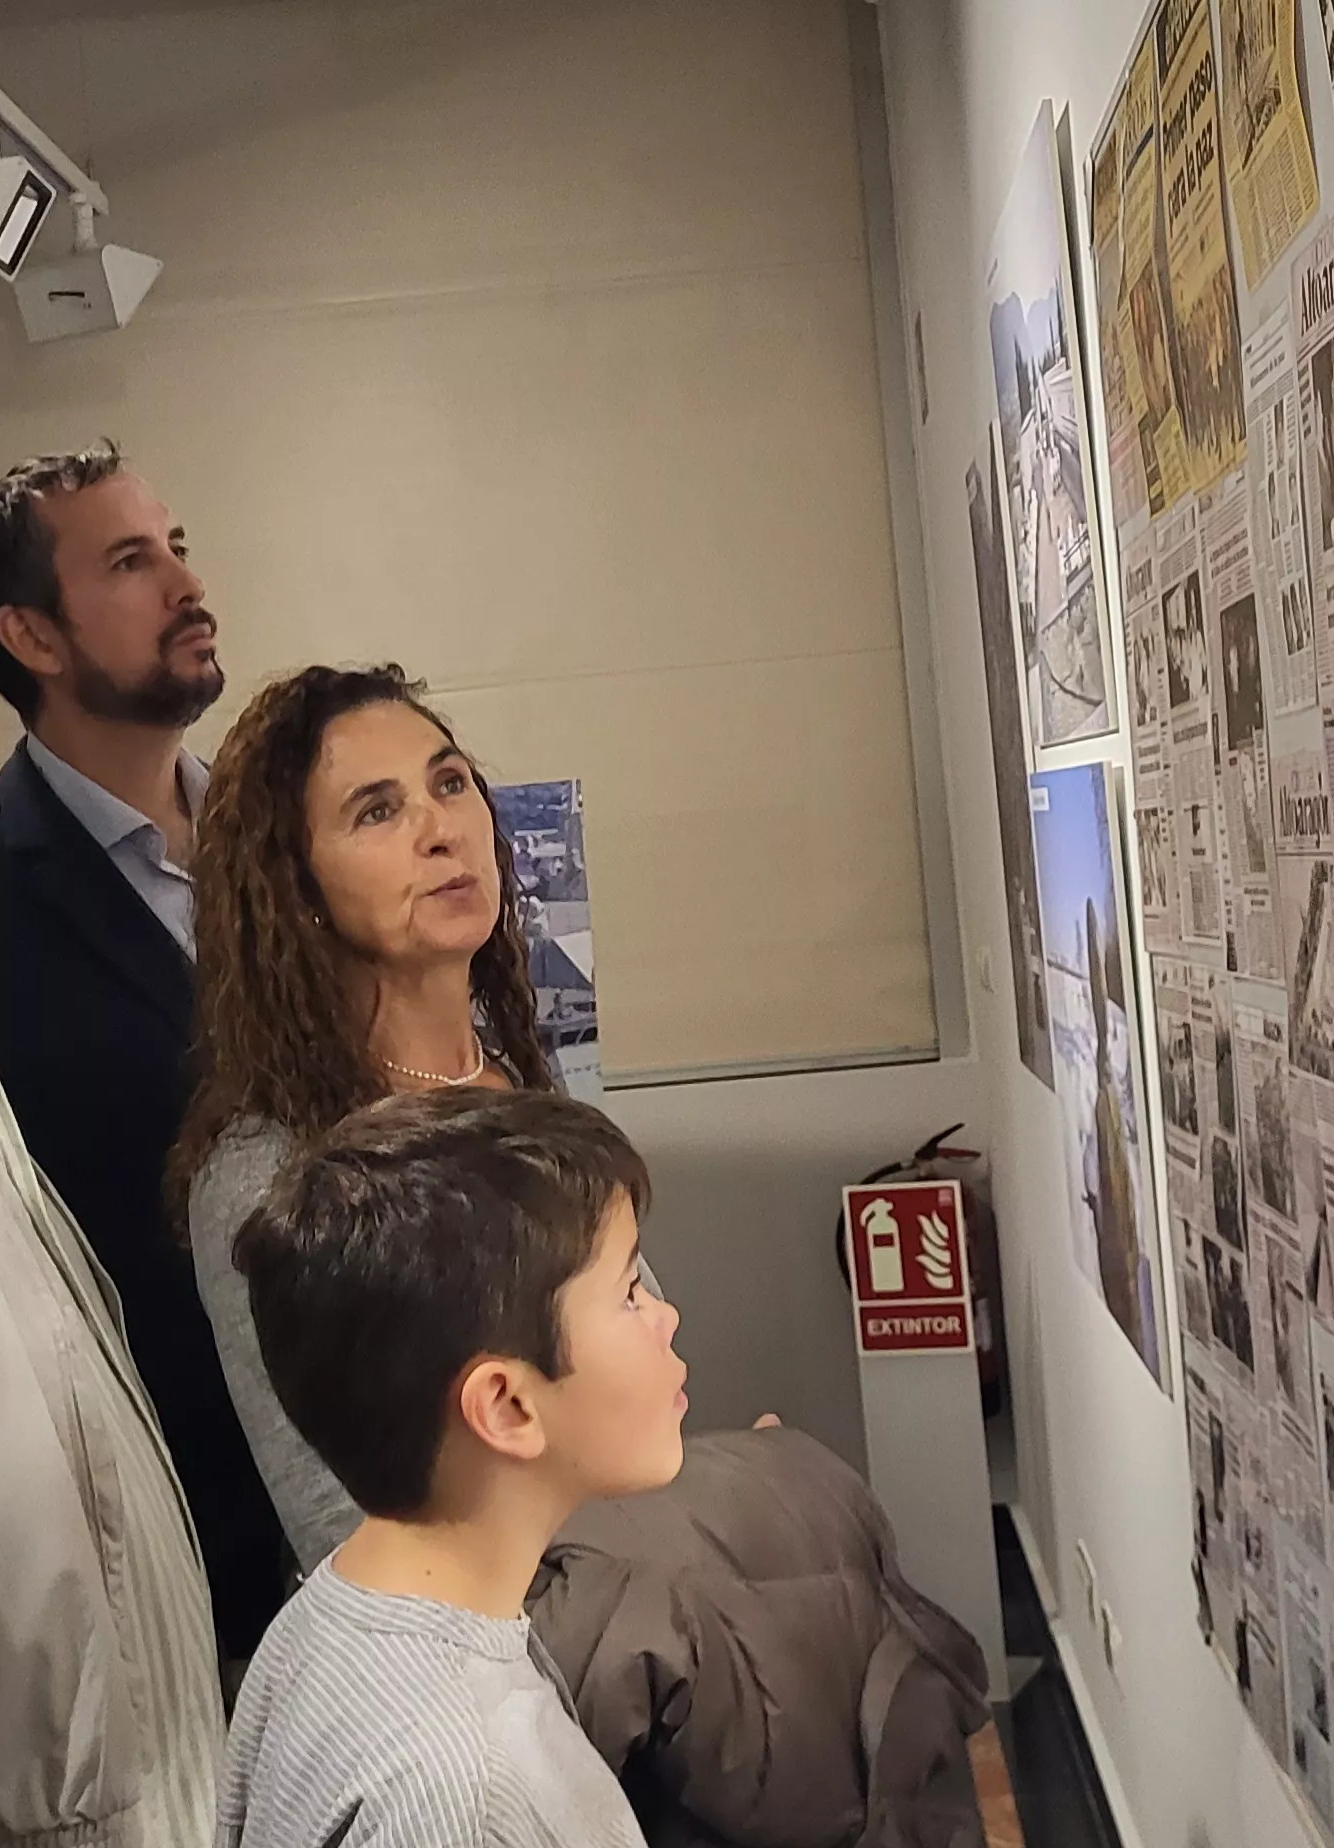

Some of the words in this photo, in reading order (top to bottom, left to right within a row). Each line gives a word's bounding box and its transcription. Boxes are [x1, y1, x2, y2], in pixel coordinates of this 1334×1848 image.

[1189, 50, 1212, 134] paso
[1195, 118, 1214, 192] paz
[867, 1315, 961, 1337] EXTINTOR
